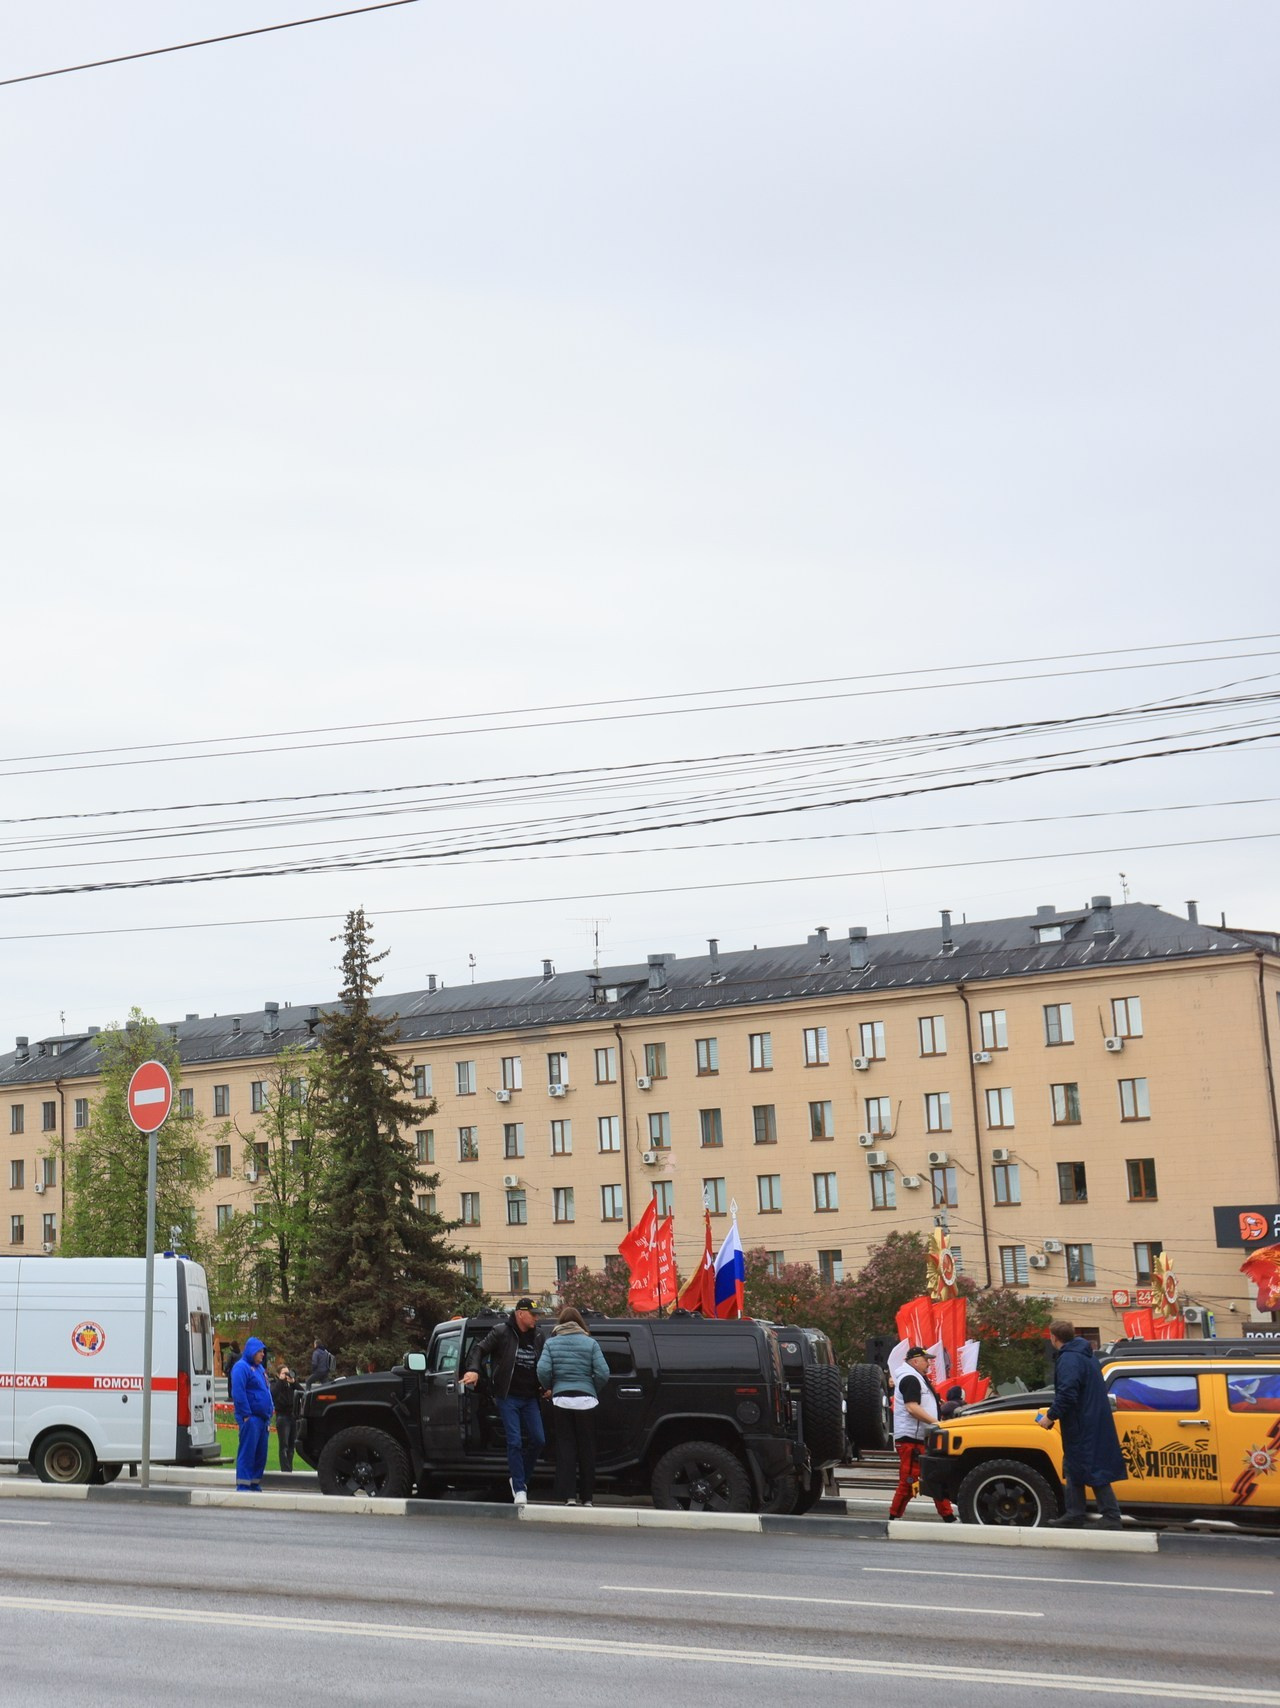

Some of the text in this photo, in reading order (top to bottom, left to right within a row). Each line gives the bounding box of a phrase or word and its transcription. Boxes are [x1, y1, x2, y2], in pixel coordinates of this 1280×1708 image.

[1138, 1291, 1152, 1300] 24
[93, 1377, 145, 1391] ПОМОЩ
[1145, 1451, 1160, 1478] Я
